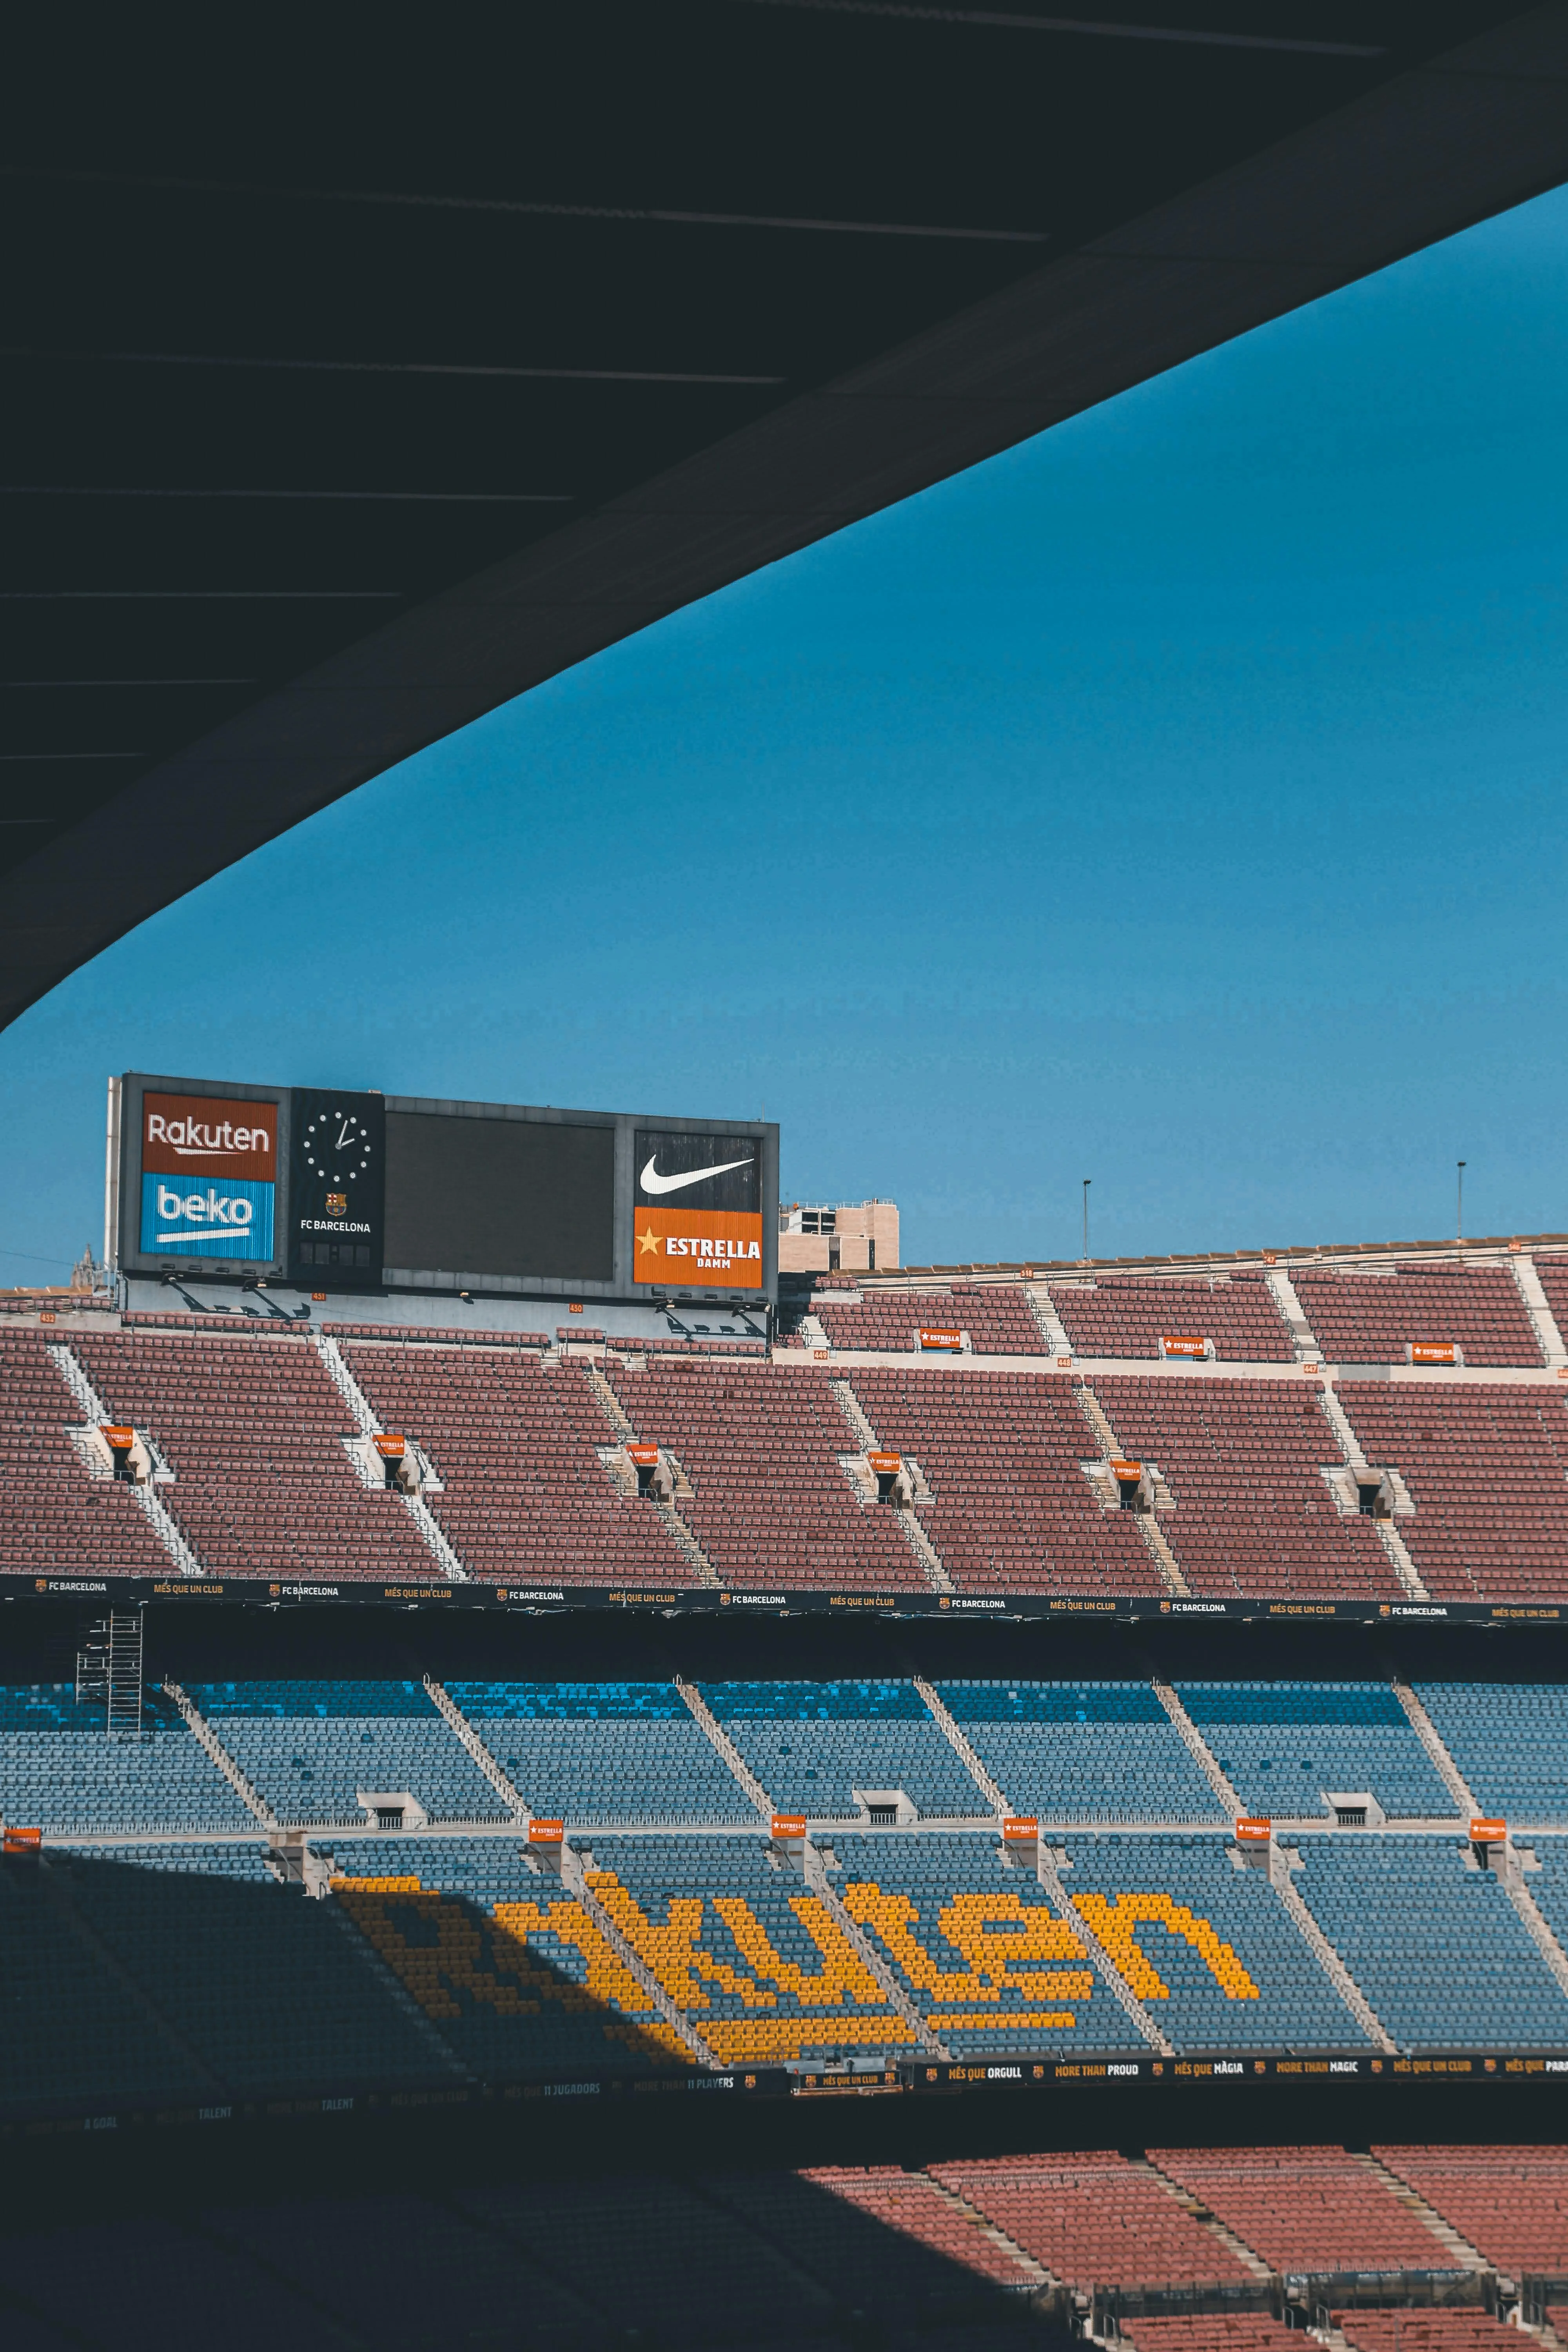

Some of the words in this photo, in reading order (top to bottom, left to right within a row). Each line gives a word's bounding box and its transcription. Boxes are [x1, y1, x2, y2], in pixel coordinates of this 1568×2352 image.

[148, 1114, 269, 1152] Rakuten
[158, 1185, 252, 1225] beko
[301, 1220, 312, 1229] FC
[314, 1220, 371, 1233] BARCELONA
[666, 1237, 760, 1259] ESTRELLA
[697, 1258, 731, 1269] DAMM
[49, 1582, 58, 1590] FC
[60, 1583, 106, 1591] BARCELONA
[154, 1583, 171, 1593] MÉS
[172, 1585, 189, 1594] QUE
[293, 1587, 338, 1595] BARCELONA
[385, 1587, 401, 1597] MÉS
[403, 1590, 418, 1599] QUE
[519, 1592, 564, 1600] BARCELONA
[609, 1592, 625, 1601] MÉS
[627, 1594, 642, 1603] QUE
[830, 1595, 846, 1605] MÉS
[847, 1597, 862, 1606] QUE
[1050, 1600, 1066, 1609] MÉS
[1067, 1602, 1083, 1611] QUE
[328, 1871, 1260, 2019] Rakuten
[949, 2066, 966, 2079] MÉS
[968, 2068, 986, 2081] QUE
[988, 2067, 1022, 2078] ORGULL
[1055, 2065, 1080, 2077] MORE
[1082, 2065, 1106, 2076] THAN
[1108, 2064, 1138, 2076] PROUD
[1174, 2061, 1192, 2075] MÉS
[1193, 2064, 1212, 2077] QUE
[1214, 2061, 1243, 2074] MÀGIA
[1277, 2062, 1303, 2073] MORE
[1304, 2062, 1328, 2073] THAN
[1330, 2061, 1359, 2073] MAGIC
[634, 2080, 659, 2091] MORE
[662, 2080, 686, 2091] THAN
[697, 2077, 734, 2089] PLAYERS
[823, 2076, 836, 2085] MÉS
[837, 2076, 850, 2086] QUE
[851, 2076, 861, 2084] UN
[862, 2075, 878, 2084] CLUB
[553, 2083, 600, 2096] JUGADORS
[322, 2098, 354, 2111] TALENT
[198, 2106, 233, 2120] TALENT
[93, 2116, 118, 2129] GOAL
